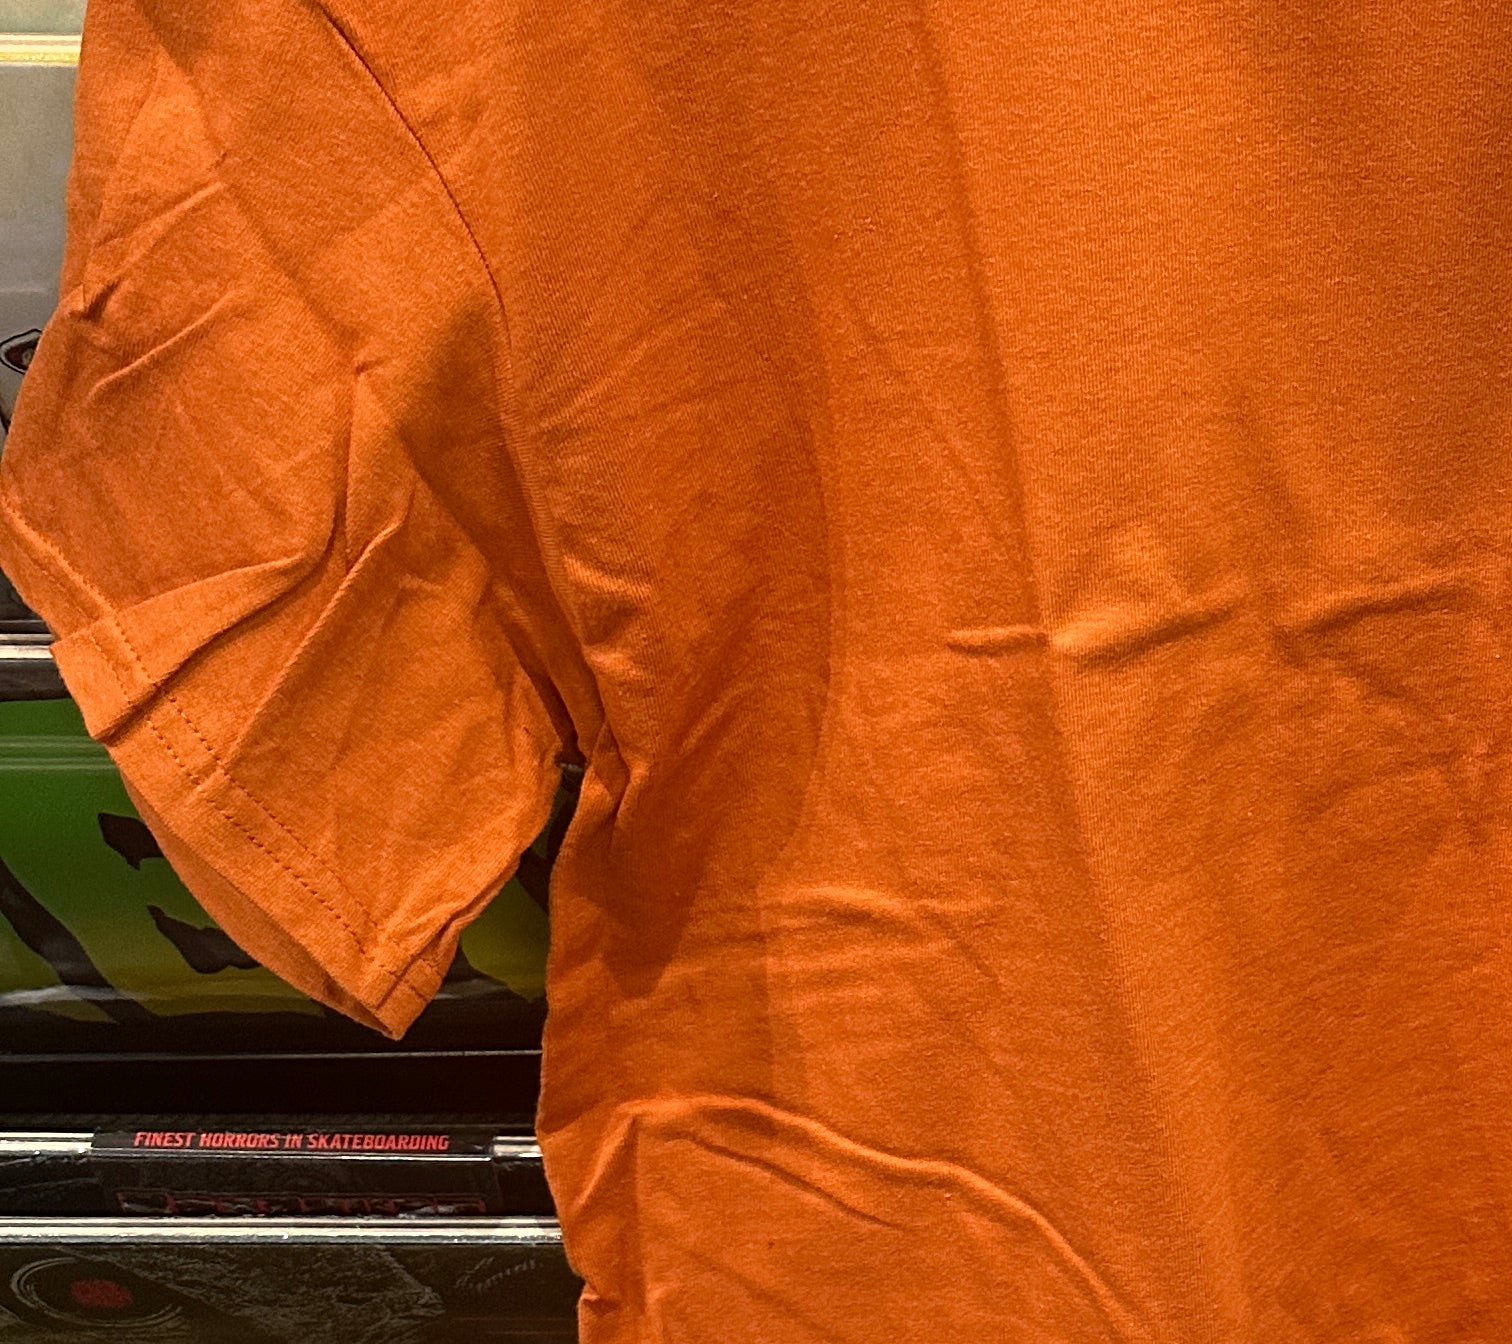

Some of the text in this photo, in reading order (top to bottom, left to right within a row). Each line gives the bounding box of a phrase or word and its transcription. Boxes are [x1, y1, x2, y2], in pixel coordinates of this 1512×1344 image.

[133, 1131, 450, 1151] FINEST HORRORS IN SKATEBOARDING
